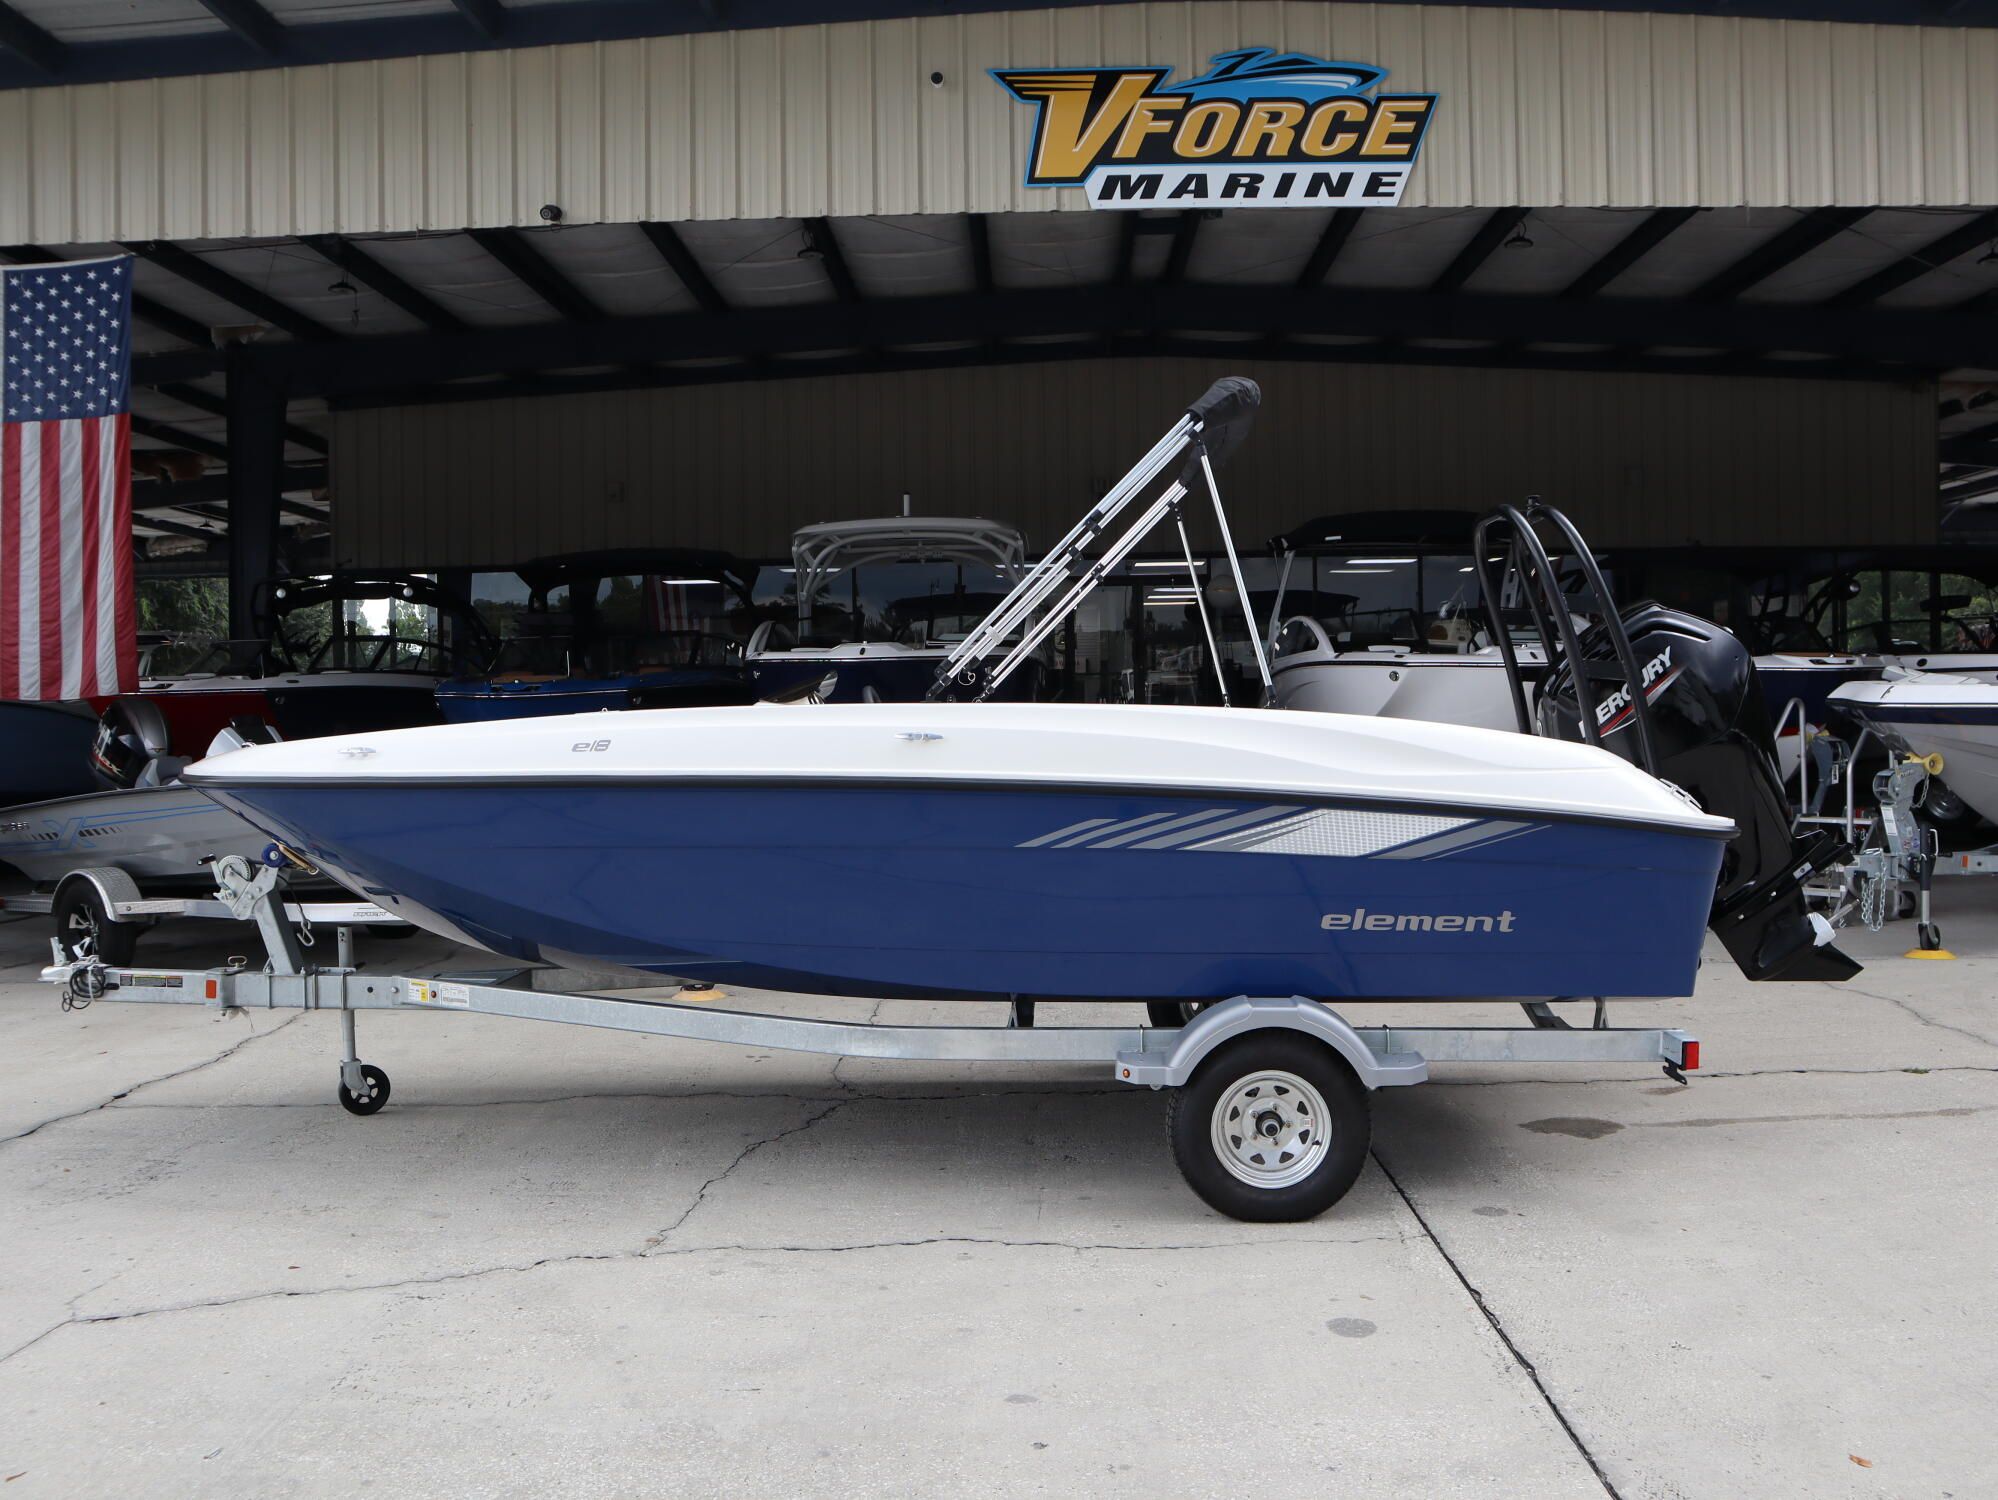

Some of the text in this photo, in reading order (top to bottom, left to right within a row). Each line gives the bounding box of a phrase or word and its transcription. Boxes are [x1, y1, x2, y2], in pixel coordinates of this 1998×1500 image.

[1097, 171, 1403, 201] MARINE
[1579, 645, 1672, 738] ERCRY
[1320, 908, 1517, 933] element
